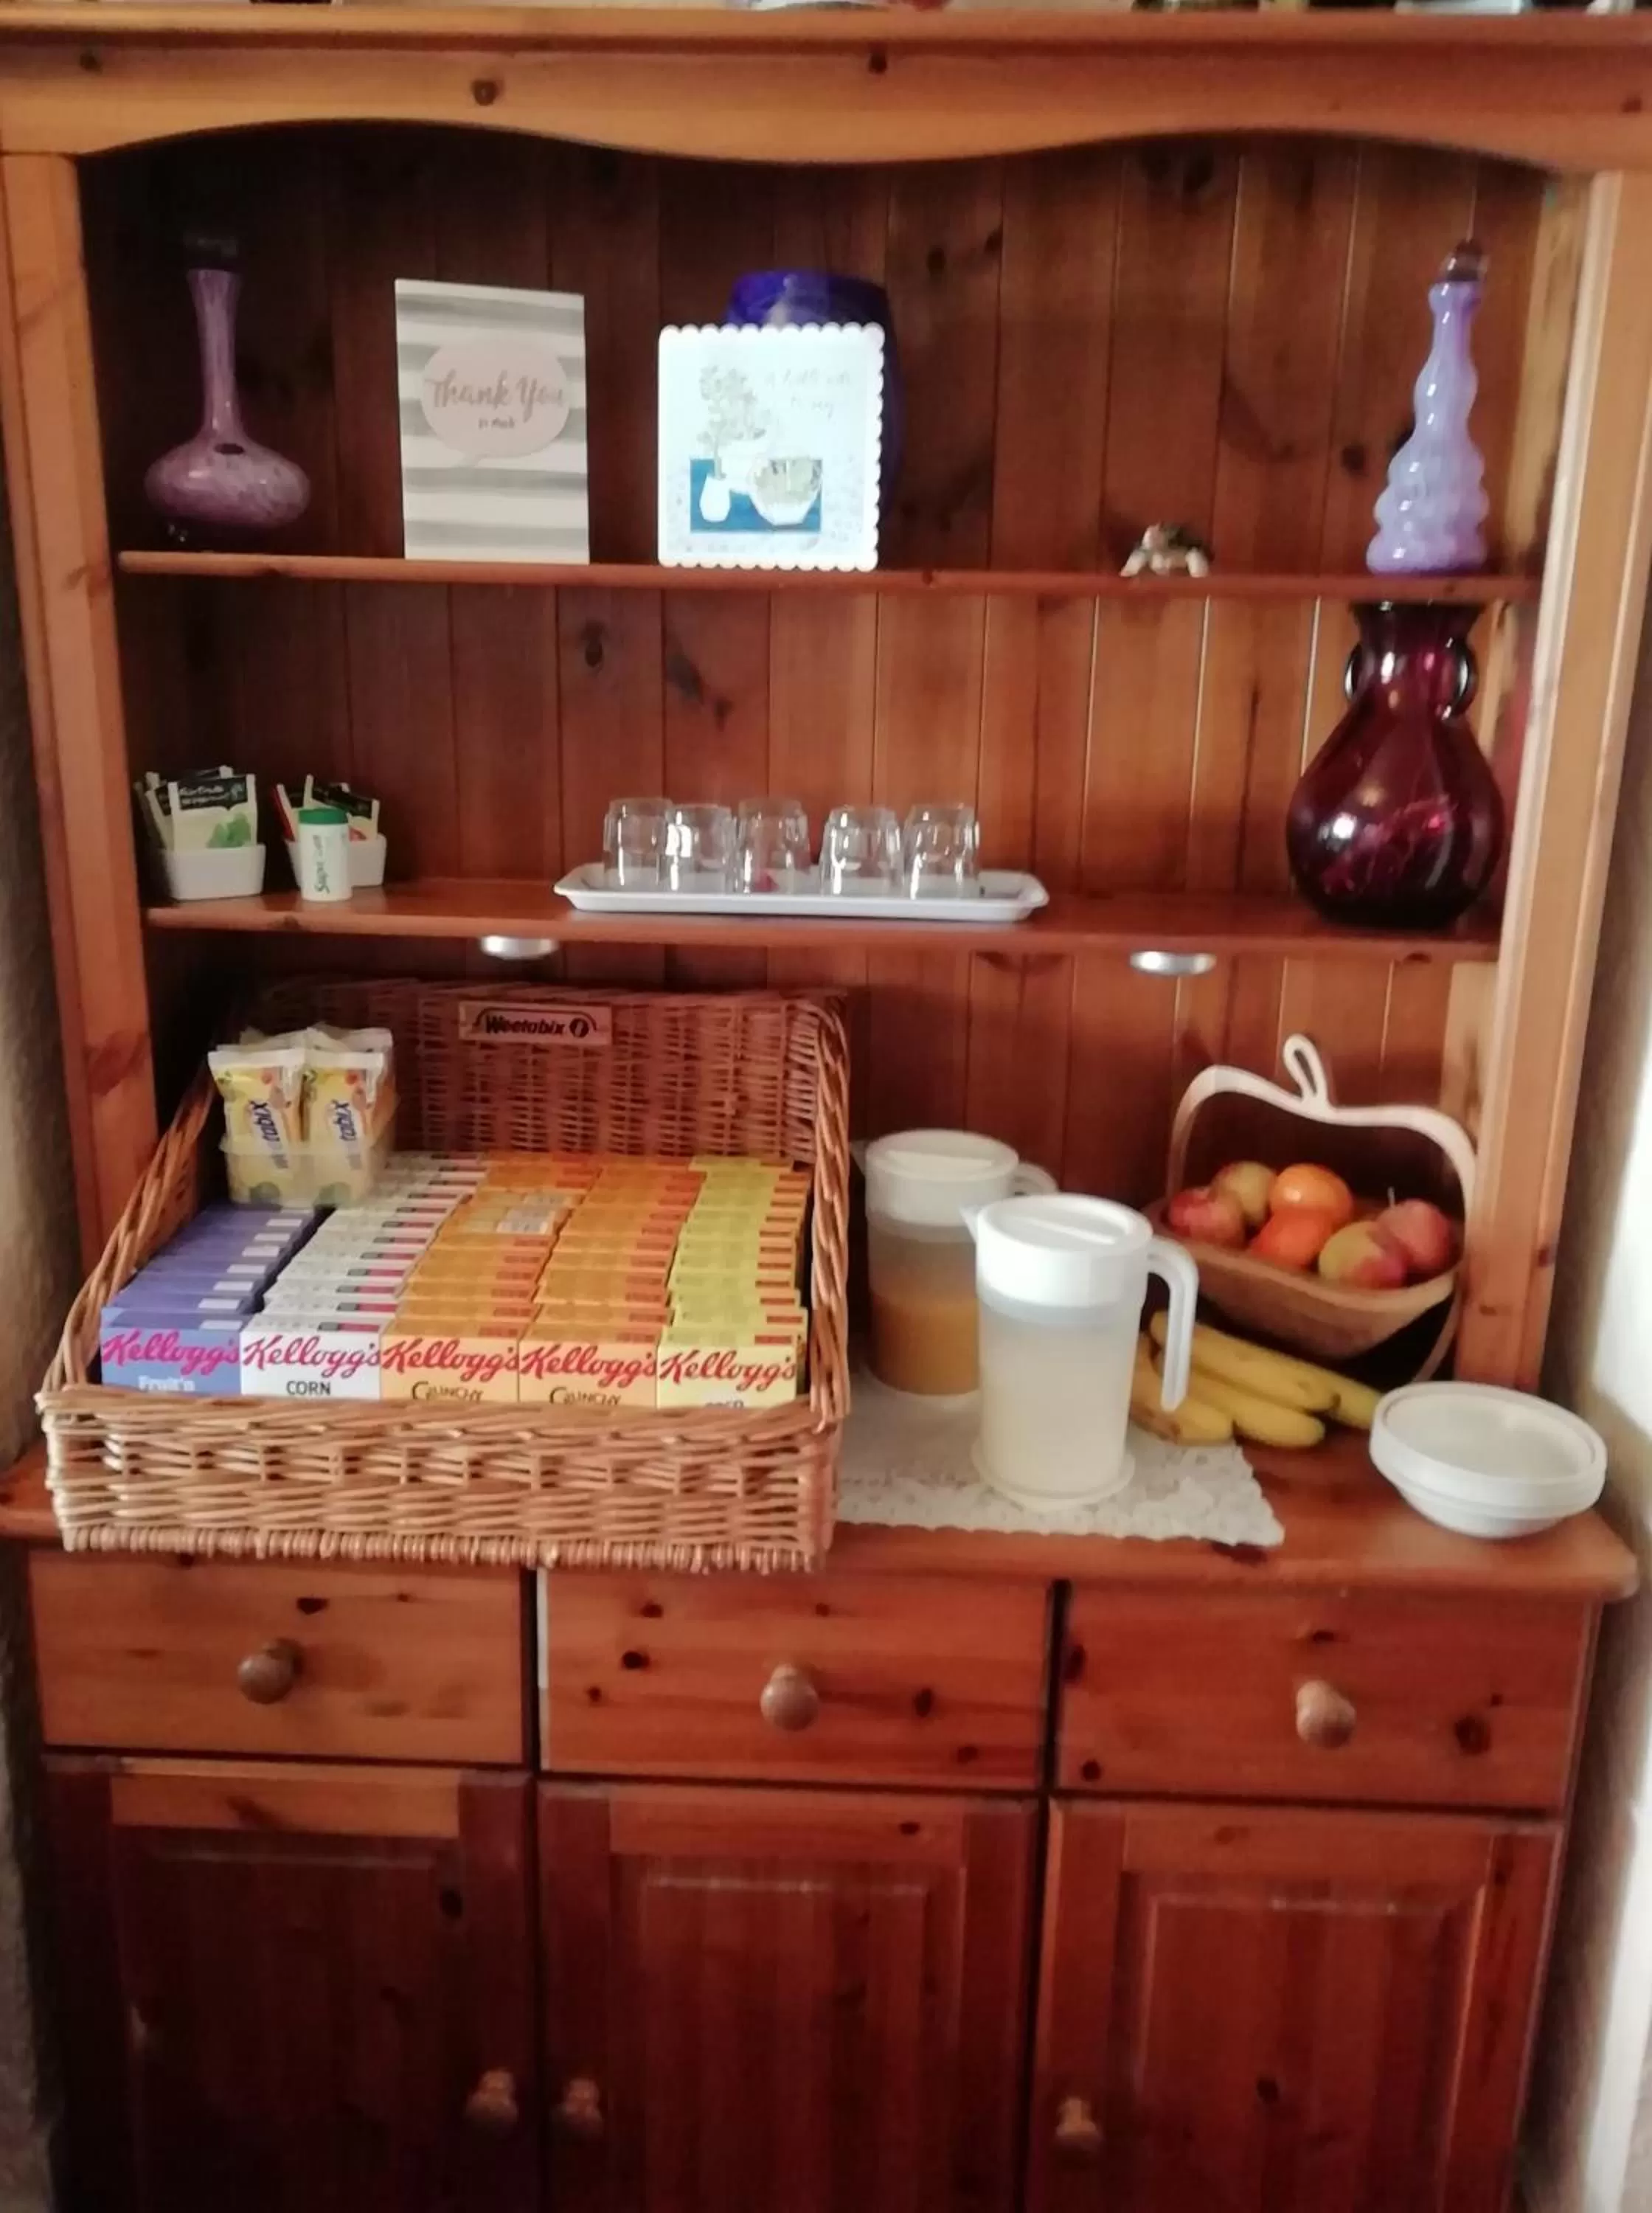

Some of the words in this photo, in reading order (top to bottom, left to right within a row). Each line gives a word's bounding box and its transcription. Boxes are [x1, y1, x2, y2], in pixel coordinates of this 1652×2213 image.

[426, 368, 509, 409] Thank
[516, 375, 563, 423] You
[485, 1014, 566, 1036] Weetabix
[103, 1328, 240, 1376] Kellogg's
[243, 1334, 382, 1379] Kellogg's
[383, 1337, 519, 1383] Kellogg's
[521, 1344, 656, 1389] Kellogg's
[659, 1349, 796, 1392] Kellogg's
[286, 1380, 331, 1396] CORN
